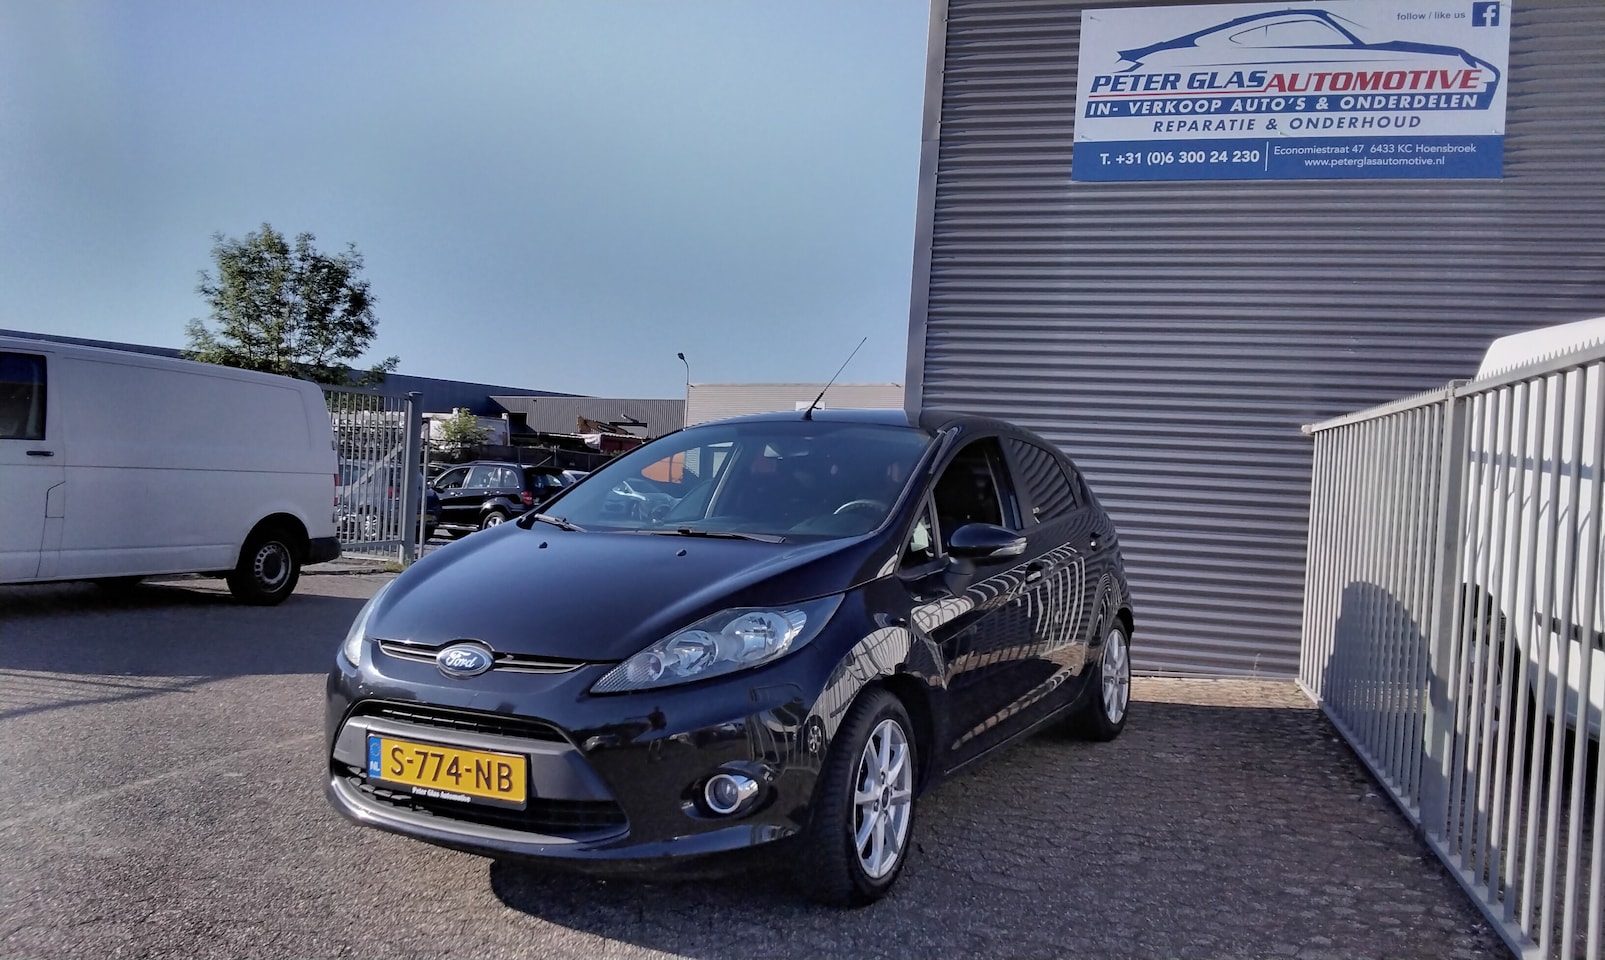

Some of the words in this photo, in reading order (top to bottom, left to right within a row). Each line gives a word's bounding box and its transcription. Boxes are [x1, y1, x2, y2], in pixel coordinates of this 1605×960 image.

[1396, 12, 1426, 21] follow
[1434, 11, 1451, 20] like
[1090, 73, 1182, 93] PETER
[1089, 102, 1119, 116] IN-
[1129, 99, 1223, 114] VERKOOP
[1230, 97, 1306, 112] AUTO'S
[1315, 97, 1329, 110] &
[1340, 94, 1478, 109] ONDERDELEN
[1153, 118, 1256, 133] REPARATIE
[1265, 118, 1278, 130] &
[1289, 115, 1421, 130] ONDERHOUD
[1274, 145, 1350, 155] Economiestraat
[1351, 144, 1364, 154] 47
[1370, 144, 1395, 153] 6433
[1397, 144, 1413, 153] KC
[1415, 143, 1477, 153] Hoensbroek
[1100, 153, 1111, 165] T.
[1115, 152, 1142, 165] +31
[1147, 151, 1174, 166] (0)6
[1178, 151, 1205, 164] 300
[1209, 150, 1228, 163] 24
[1232, 150, 1260, 163] 230
[1304, 156, 1446, 168] www.peterglasautomotive.nl
[446, 650, 478, 669] Ford
[369, 760, 381, 772] NL
[390, 744, 514, 793] S-774-NB
